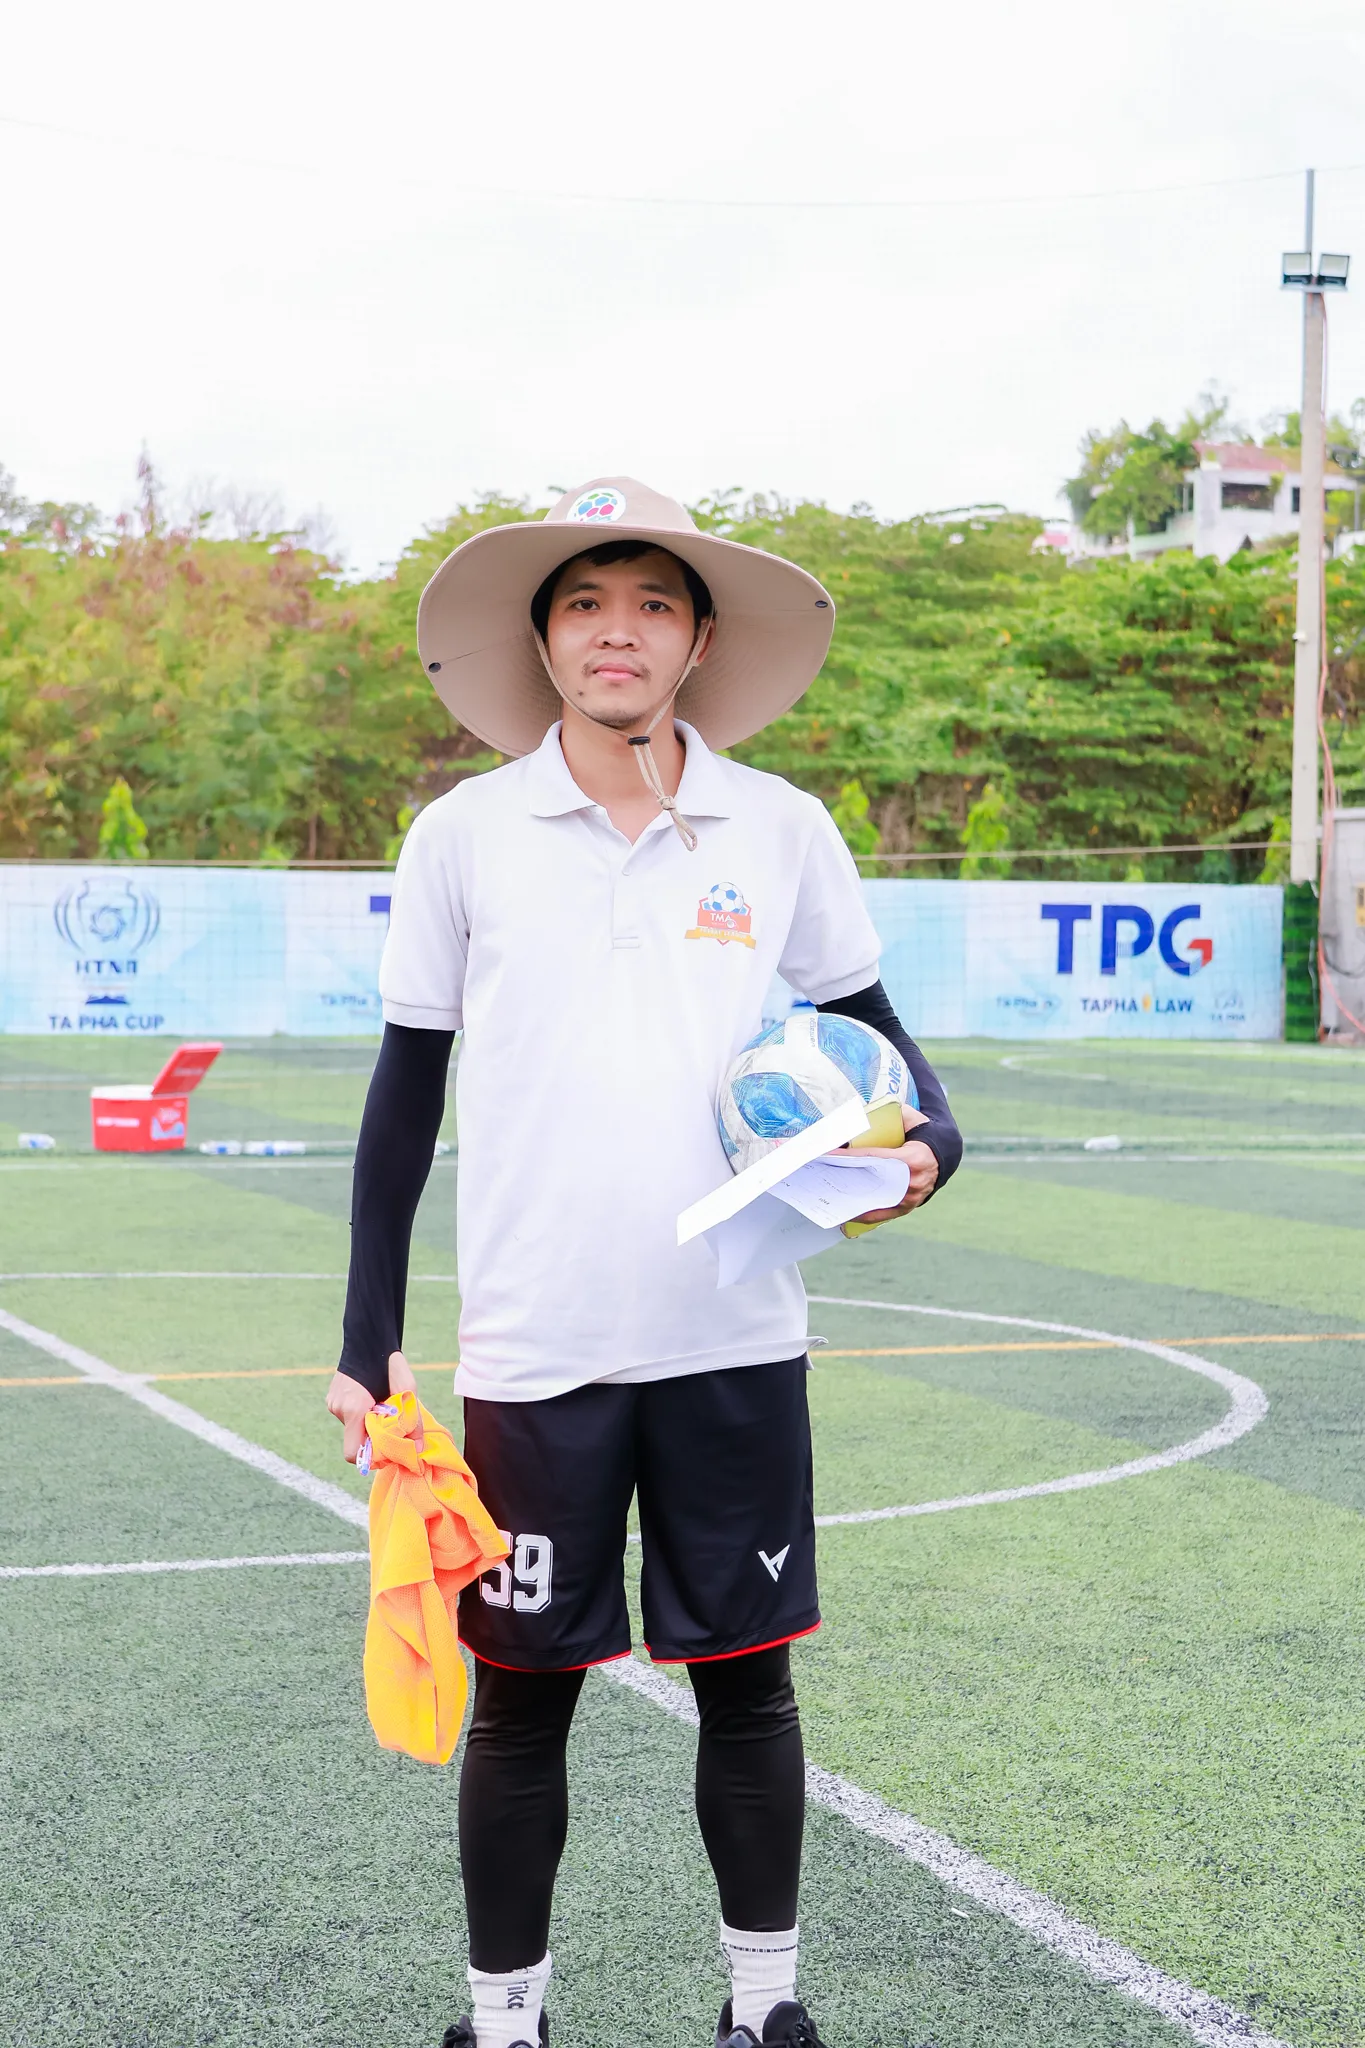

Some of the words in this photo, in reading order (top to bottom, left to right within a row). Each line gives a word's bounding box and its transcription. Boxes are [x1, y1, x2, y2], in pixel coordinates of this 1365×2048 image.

[710, 912, 732, 923] TMA
[1041, 904, 1213, 977] TPG
[1154, 996, 1194, 1013] LAW
[49, 1015, 72, 1029] TA
[79, 1015, 119, 1029] PHA
[125, 1015, 165, 1030] CUP
[886, 1048, 902, 1095] olten
